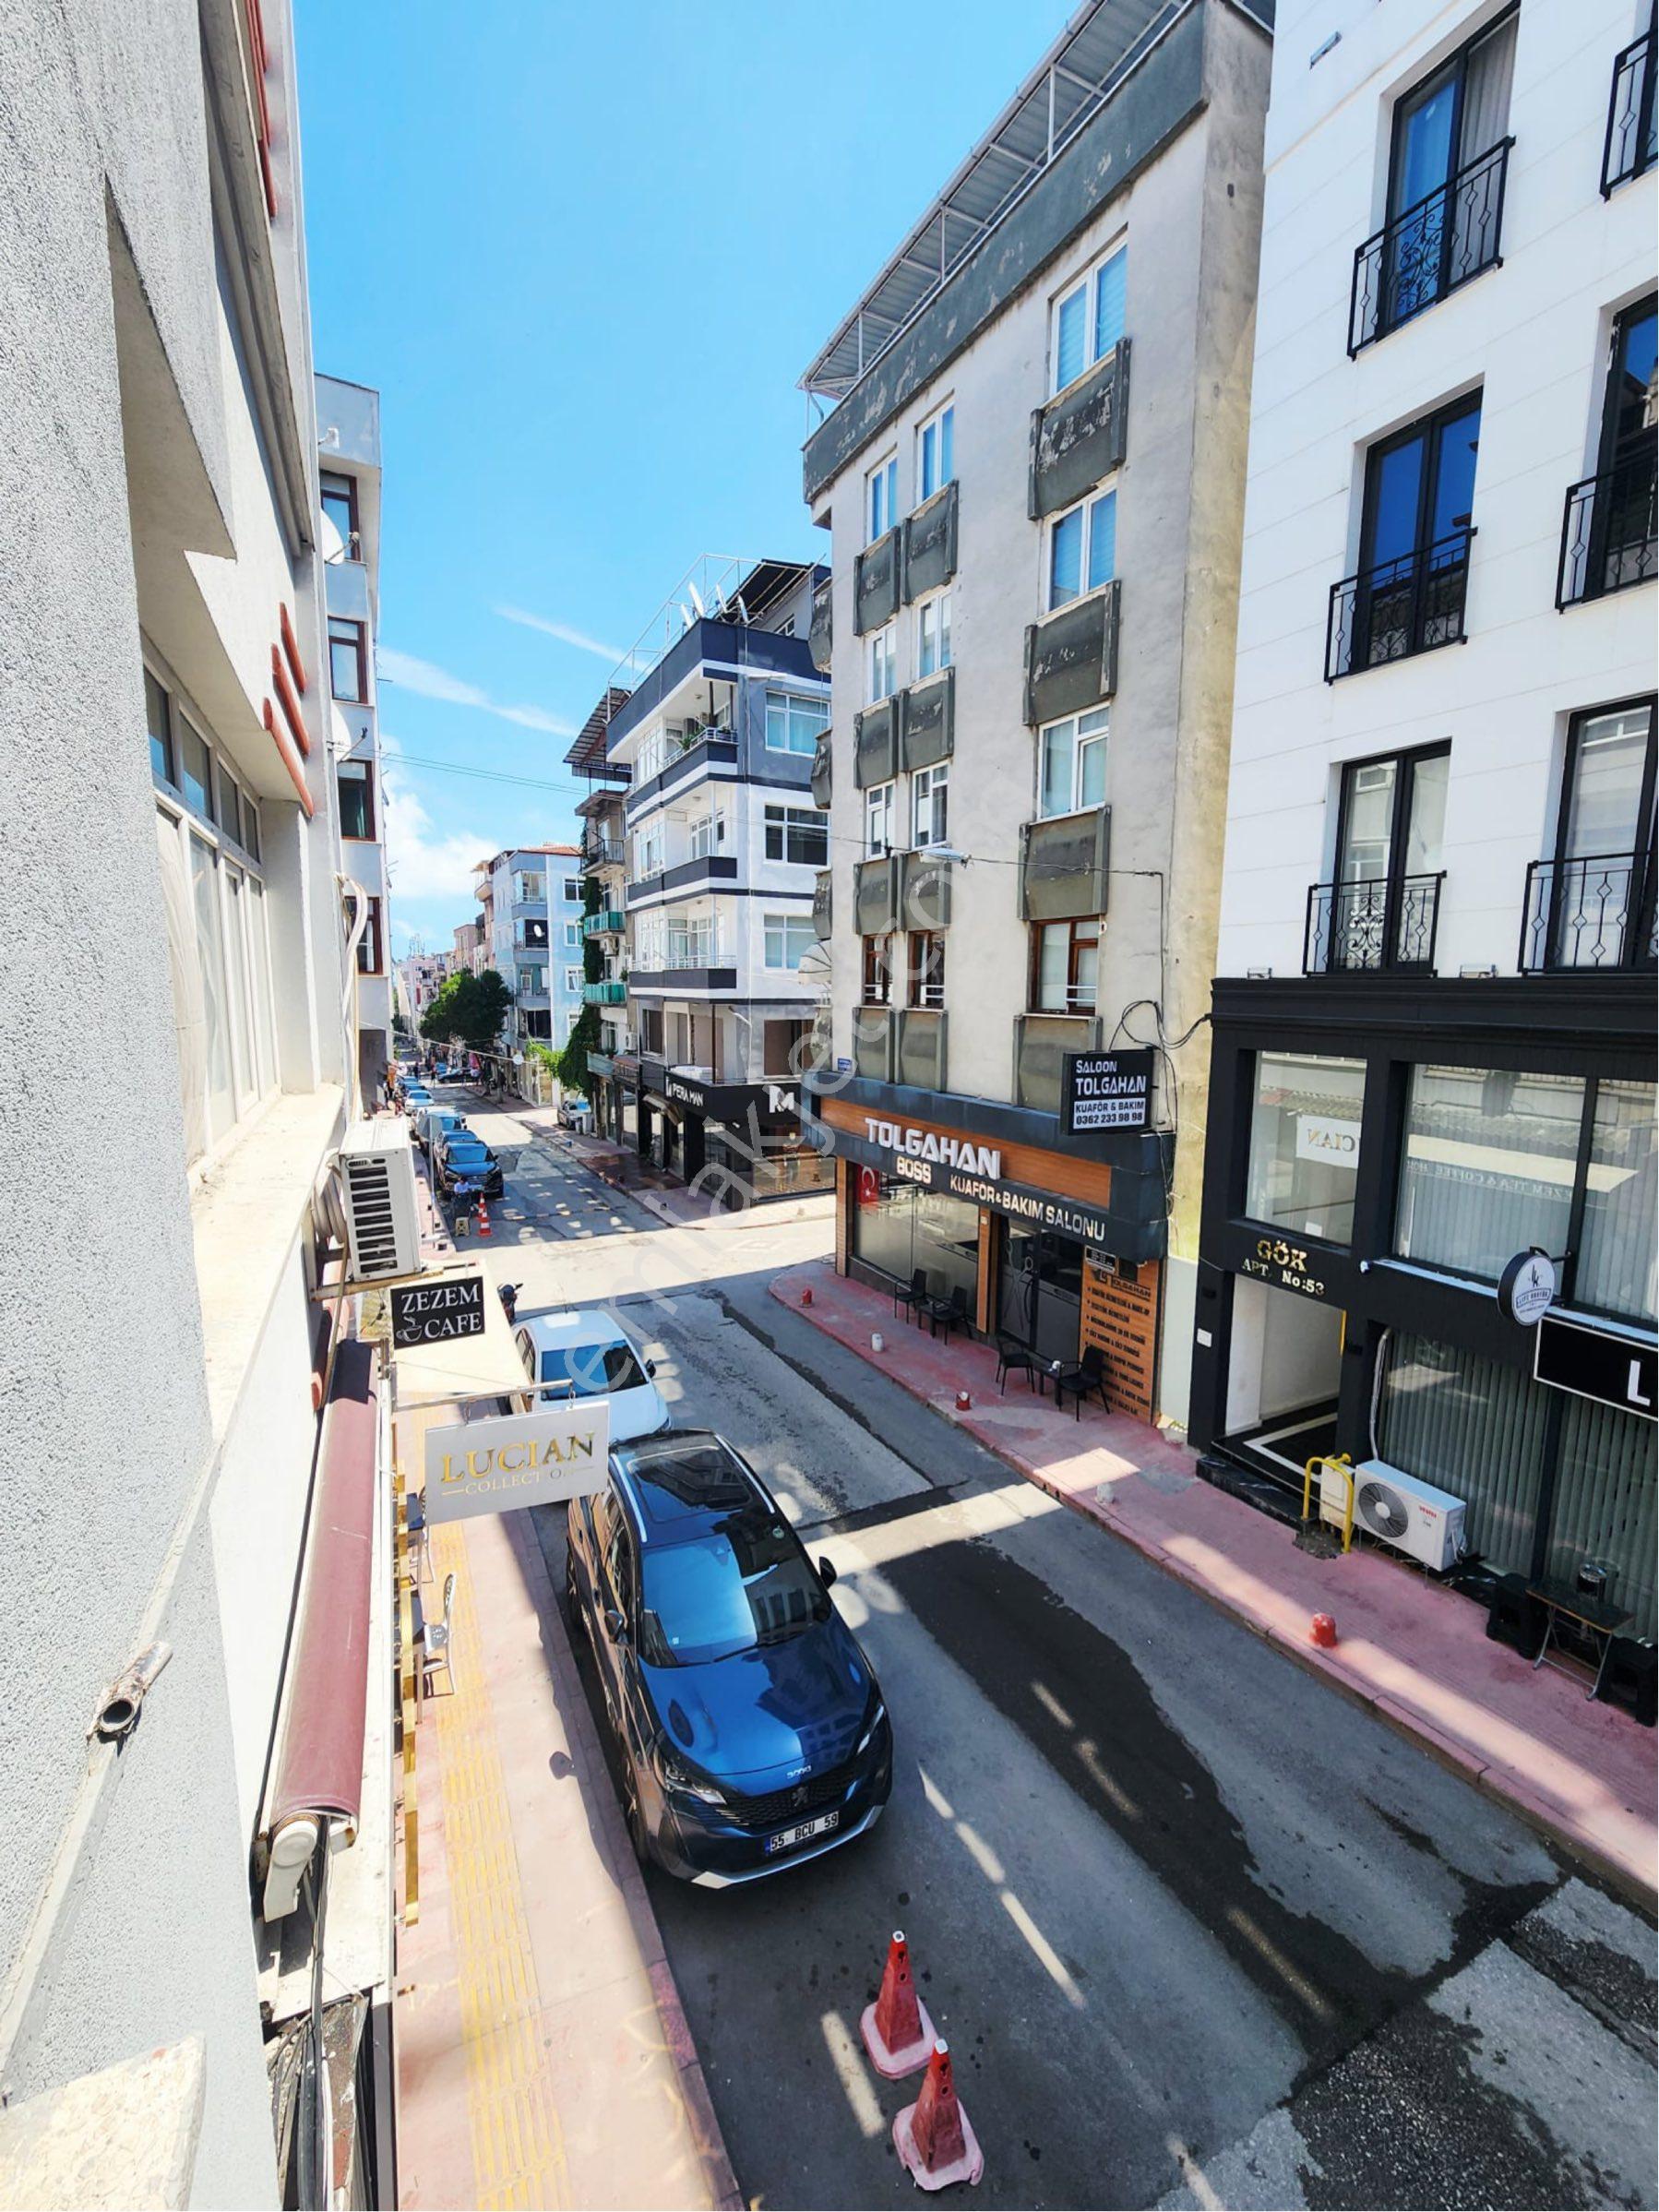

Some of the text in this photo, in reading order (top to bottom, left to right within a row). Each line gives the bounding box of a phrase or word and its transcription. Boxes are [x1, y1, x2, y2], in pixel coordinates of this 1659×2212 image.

[1076, 1059, 1117, 1074] SALOON
[689, 1090, 703, 1107] MAN
[1075, 1075, 1146, 1096] TOLGAHAN
[1076, 1115, 1099, 1125] 0362
[1101, 1113, 1117, 1124] 233
[1118, 1101, 1144, 1111] BAKIM
[864, 1117, 1001, 1180] TOLGAHAN
[896, 1155, 932, 1185] BOSS
[1002, 1190, 1044, 1221] BAKIM
[1045, 1204, 1105, 1242] SALONU
[1257, 1239, 1307, 1273] GÖK
[400, 1283, 481, 1314] ZEZEM
[424, 1311, 483, 1339] CAFE
[1627, 1359, 1651, 1407] L
[440, 1431, 596, 1484] LUCIAN
[465, 1467, 568, 1495] COLLECTO
[771, 1812, 838, 1850] 55 BCU 59
